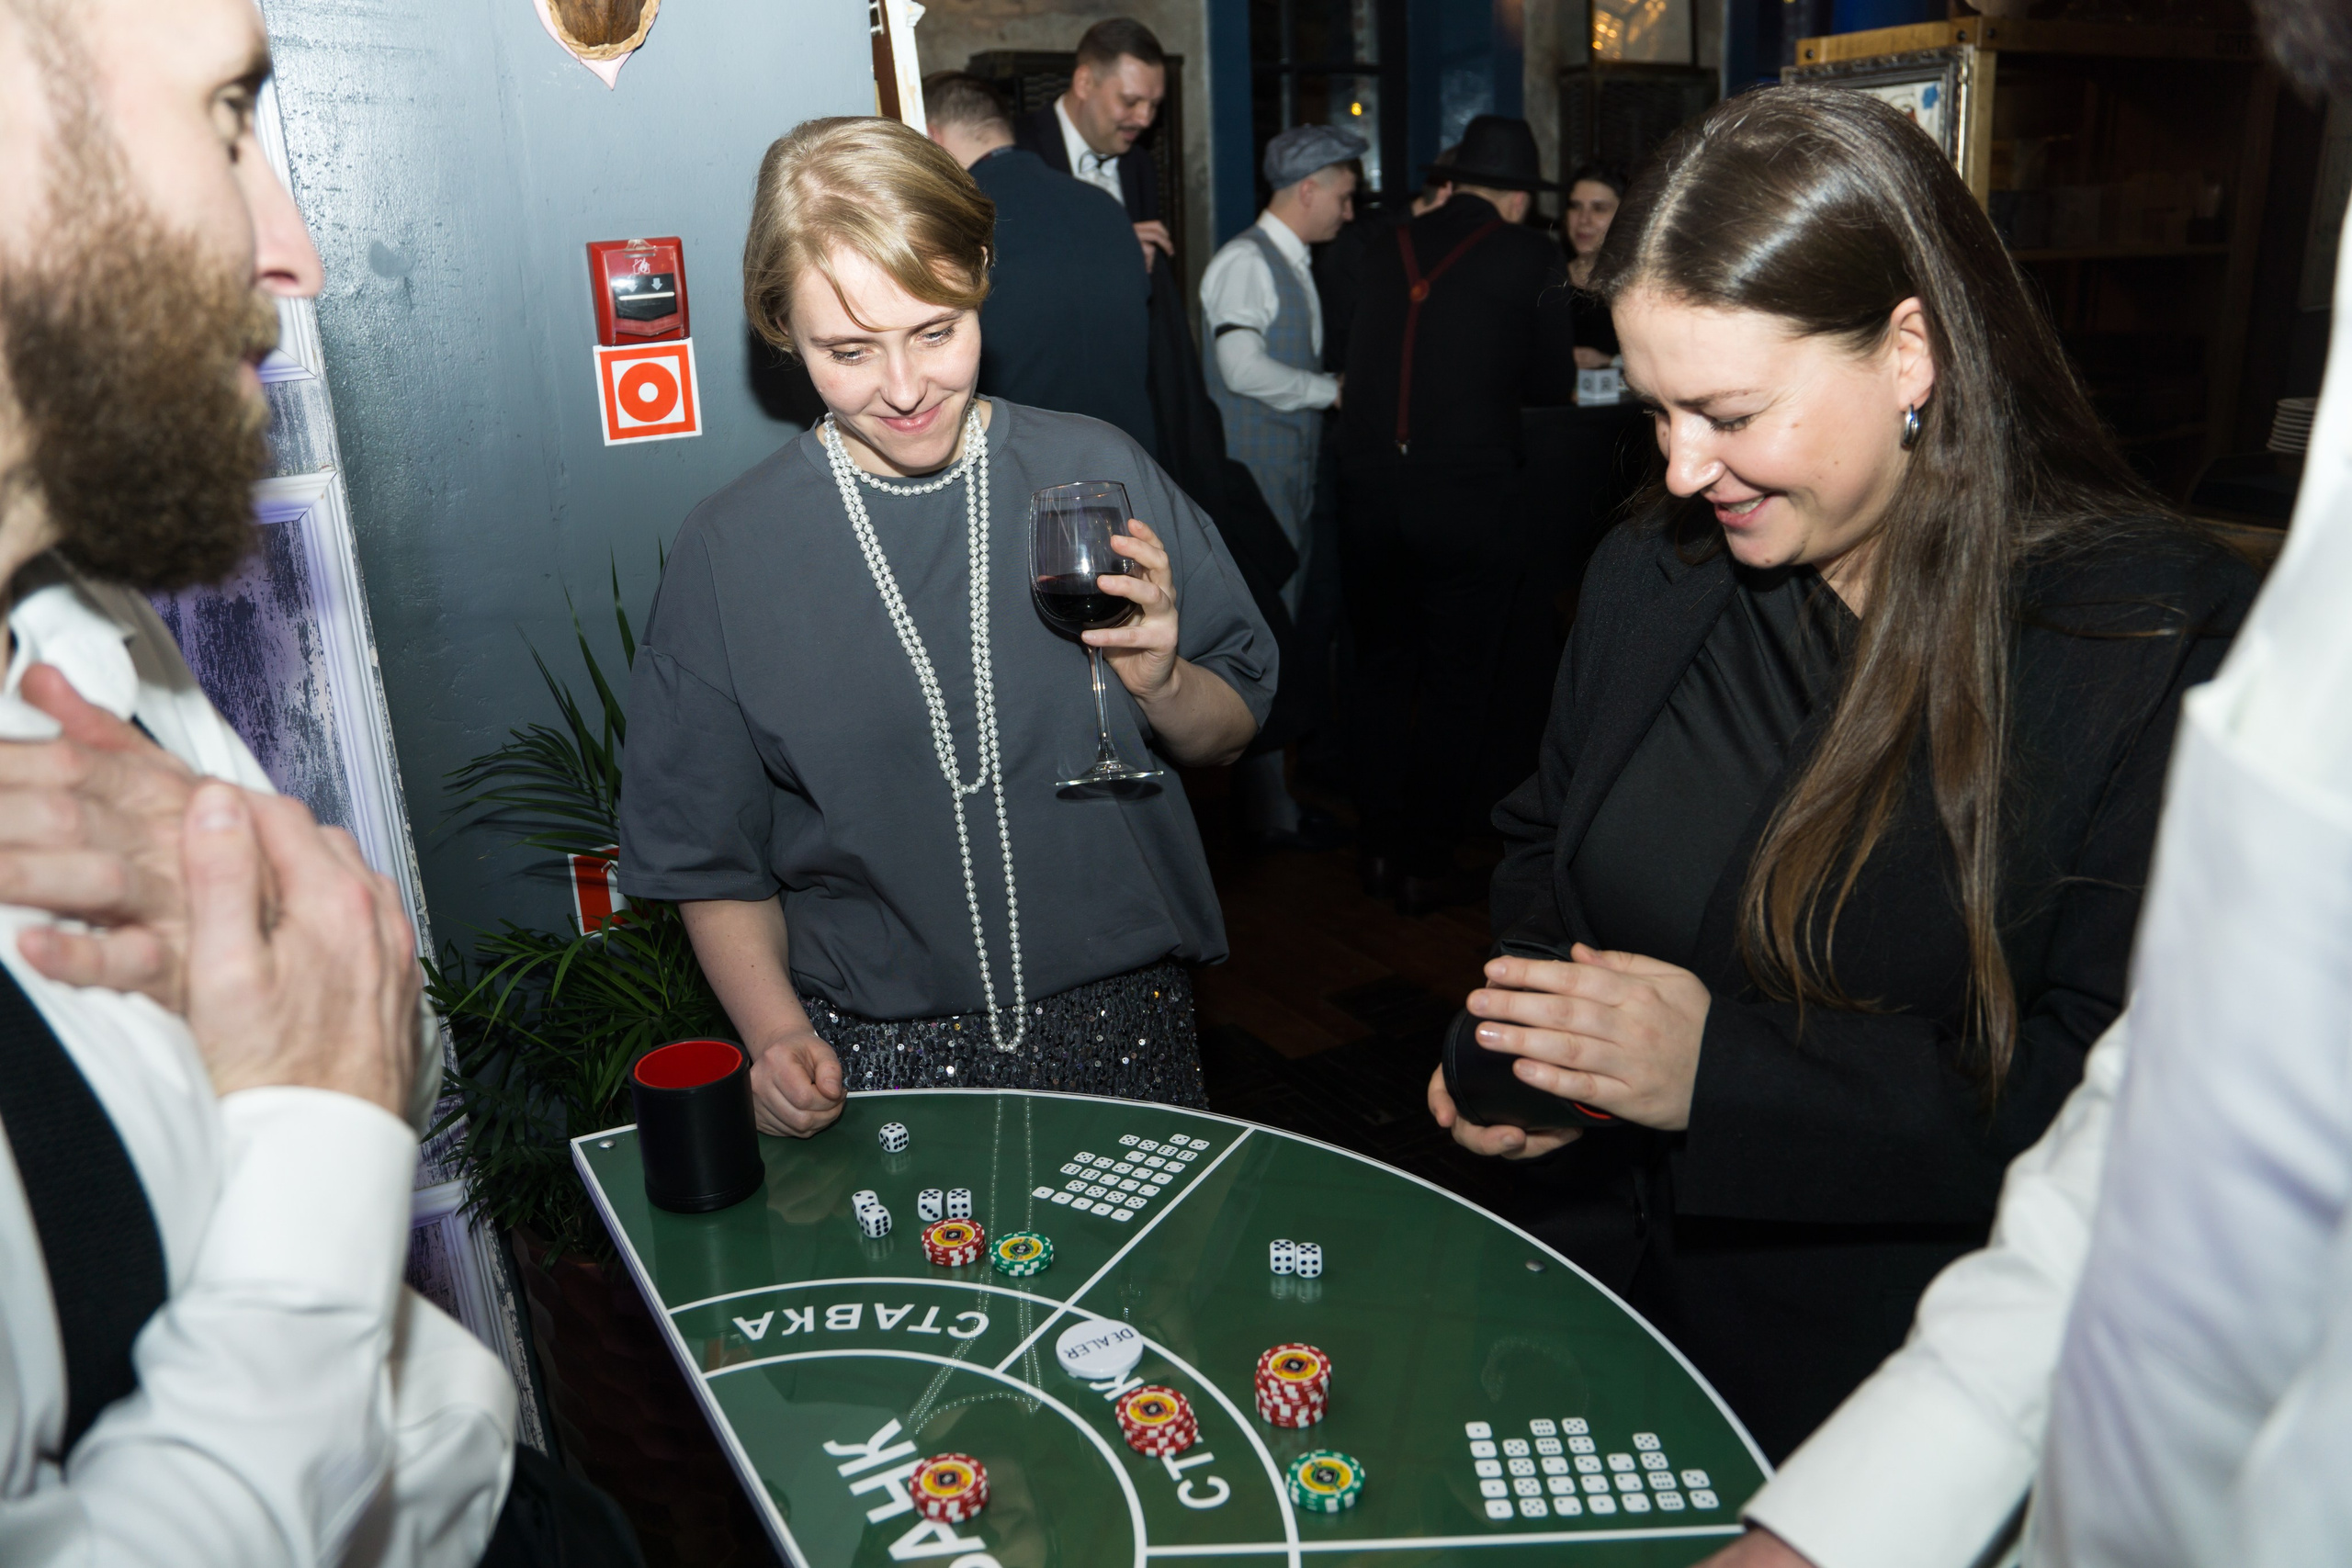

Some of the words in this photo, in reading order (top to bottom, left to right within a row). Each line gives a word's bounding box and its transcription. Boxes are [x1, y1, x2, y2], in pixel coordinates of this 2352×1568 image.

[732, 1303, 989, 1341] СТАВКА
[1063, 1327, 1135, 1360] DEALER
[1068, 1369, 1231, 1509] СТК
